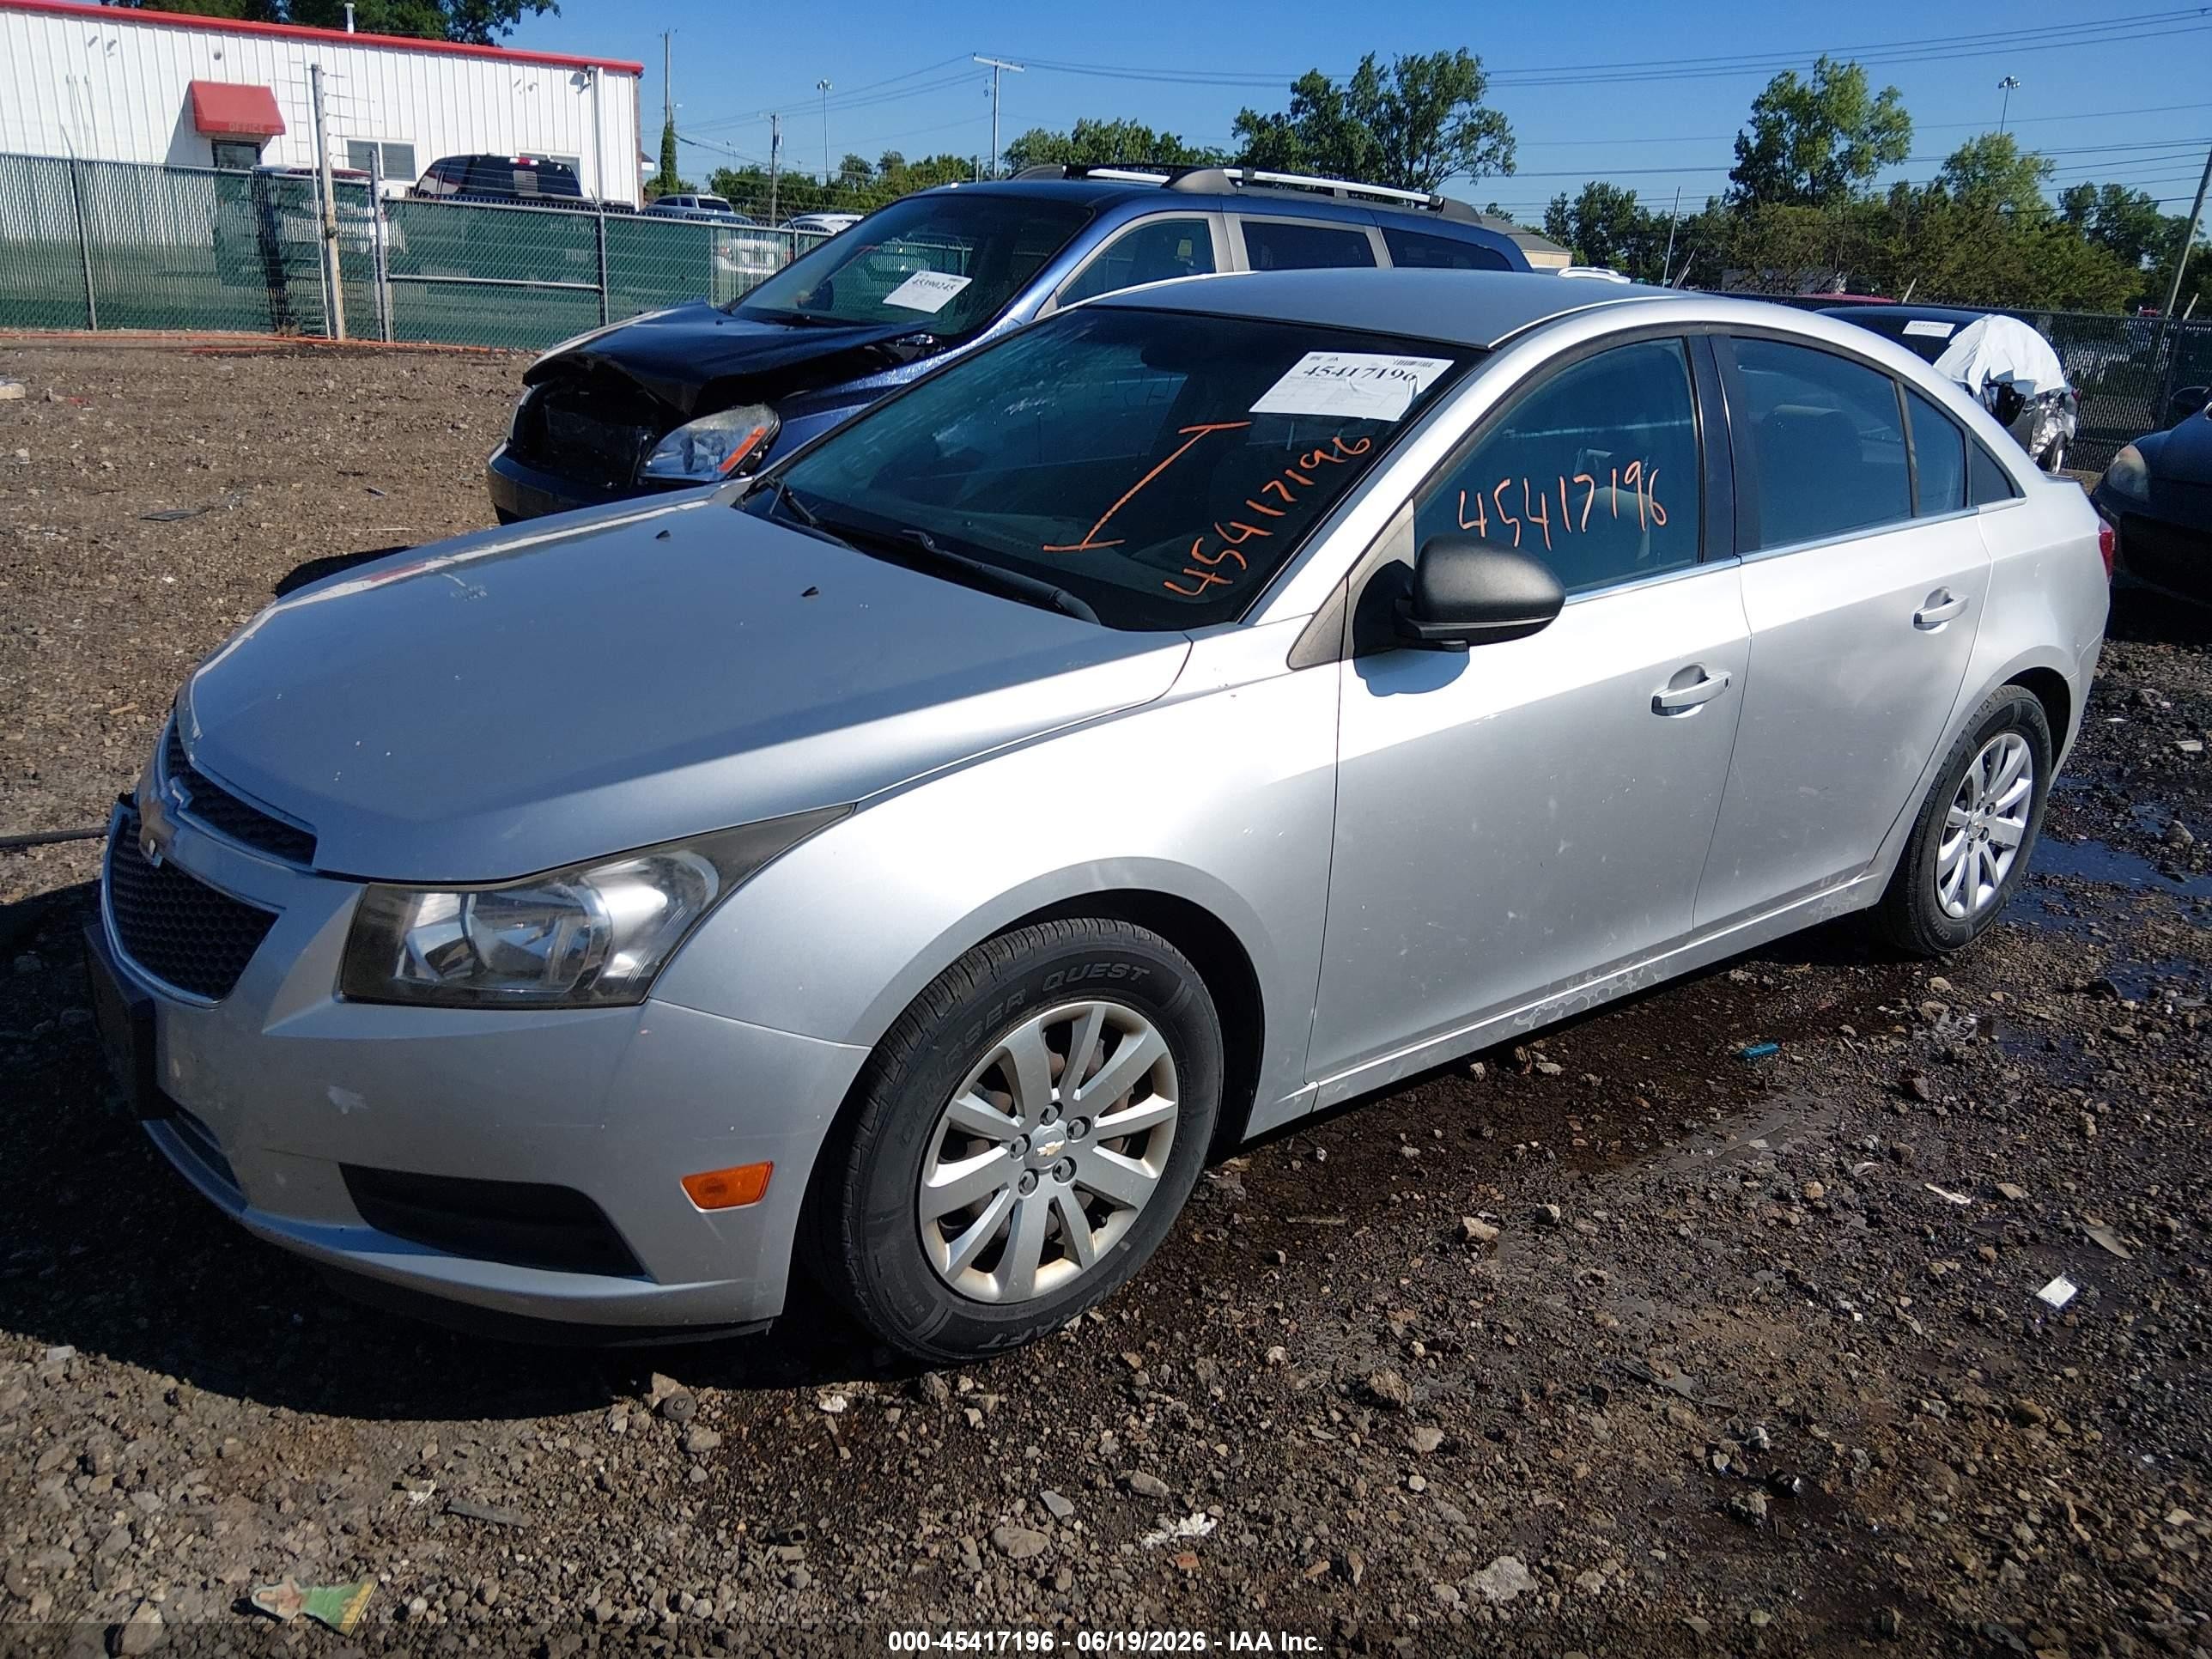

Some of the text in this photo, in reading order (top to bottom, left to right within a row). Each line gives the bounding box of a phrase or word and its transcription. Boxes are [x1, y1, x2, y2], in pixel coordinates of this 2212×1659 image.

[228, 123, 265, 134] OFFICE
[1303, 365, 1418, 381] 45417196
[1164, 435, 1371, 596] 45417196
[1458, 460, 1668, 551] 45417196
[1042, 962, 1151, 992] QUEST
